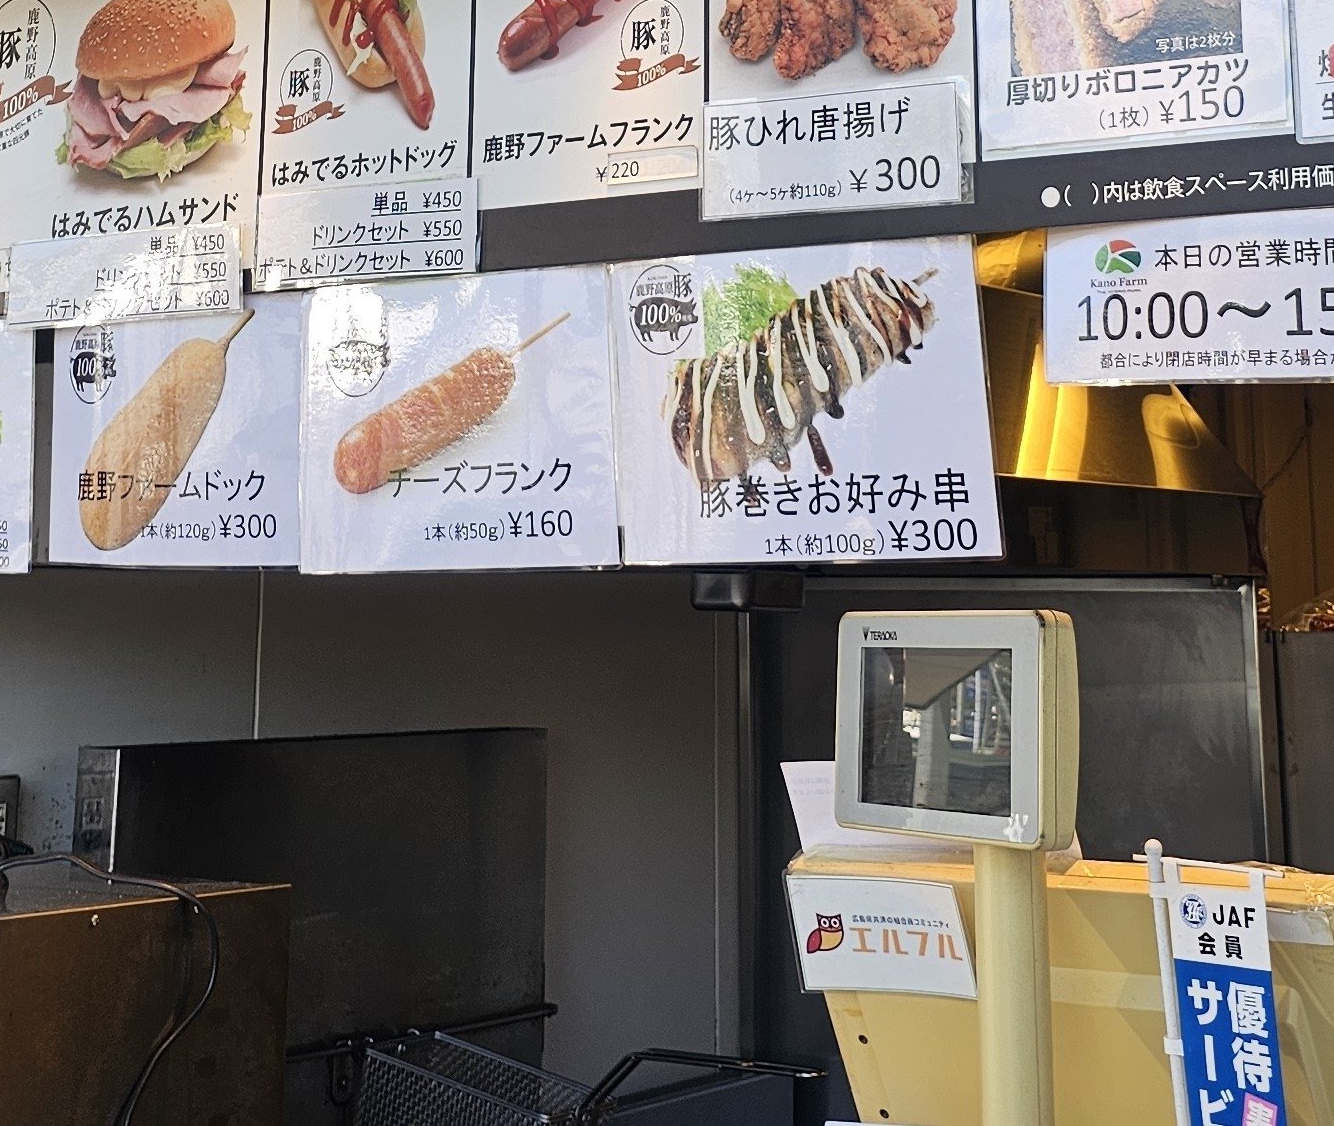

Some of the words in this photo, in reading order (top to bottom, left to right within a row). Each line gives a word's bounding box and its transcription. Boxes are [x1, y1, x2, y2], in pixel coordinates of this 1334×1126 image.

[630, 19, 657, 52] 豚
[1155, 30, 1236, 55] 写真は2枚分
[287, 68, 311, 99] 豚
[637, 64, 667, 87] 100%
[1006, 57, 1250, 107] 厚切りボロニアカツ
[3, 85, 39, 119] 100%
[1159, 85, 1245, 125] ¥150
[482, 114, 695, 164] 鹿野ファームフランク
[708, 96, 911, 152] 豚ひれ唐揚げ
[272, 140, 458, 187] はみでるホットドッグ
[596, 160, 640, 182] ¥220
[849, 154, 942, 194] ¥300
[51, 192, 240, 239] はみでるハムサンド
[372, 191, 409, 214] 単品
[423, 190, 463, 209] ¥450
[149, 235, 180, 254] 単品
[192, 234, 225, 251] ¥450
[313, 221, 410, 247] ドリンクセット
[423, 219, 463, 238] ¥550
[425, 248, 464, 267] ¥600
[1090, 279, 1116, 288] Kano
[1119, 277, 1147, 287] Farm
[640, 303, 682, 326] 100%
[77, 469, 266, 502] 鹿野ファームドック
[387, 457, 572, 497] チーズフランク
[699, 468, 970, 519] 豚巻きお好み串
[219, 514, 277, 539] ¥300
[424, 518, 506, 542] 1本(約50g)
[508, 510, 573, 538] ¥160
[765, 529, 885, 556] 1本(約100g)
[889, 518, 978, 553] ¥300
[870, 630, 898, 641] TERAOKA
[1212, 904, 1256, 929] JAF
[849, 927, 963, 961] エルフル
[1197, 932, 1243, 959] 会員
[1227, 981, 1273, 1093] 優待
